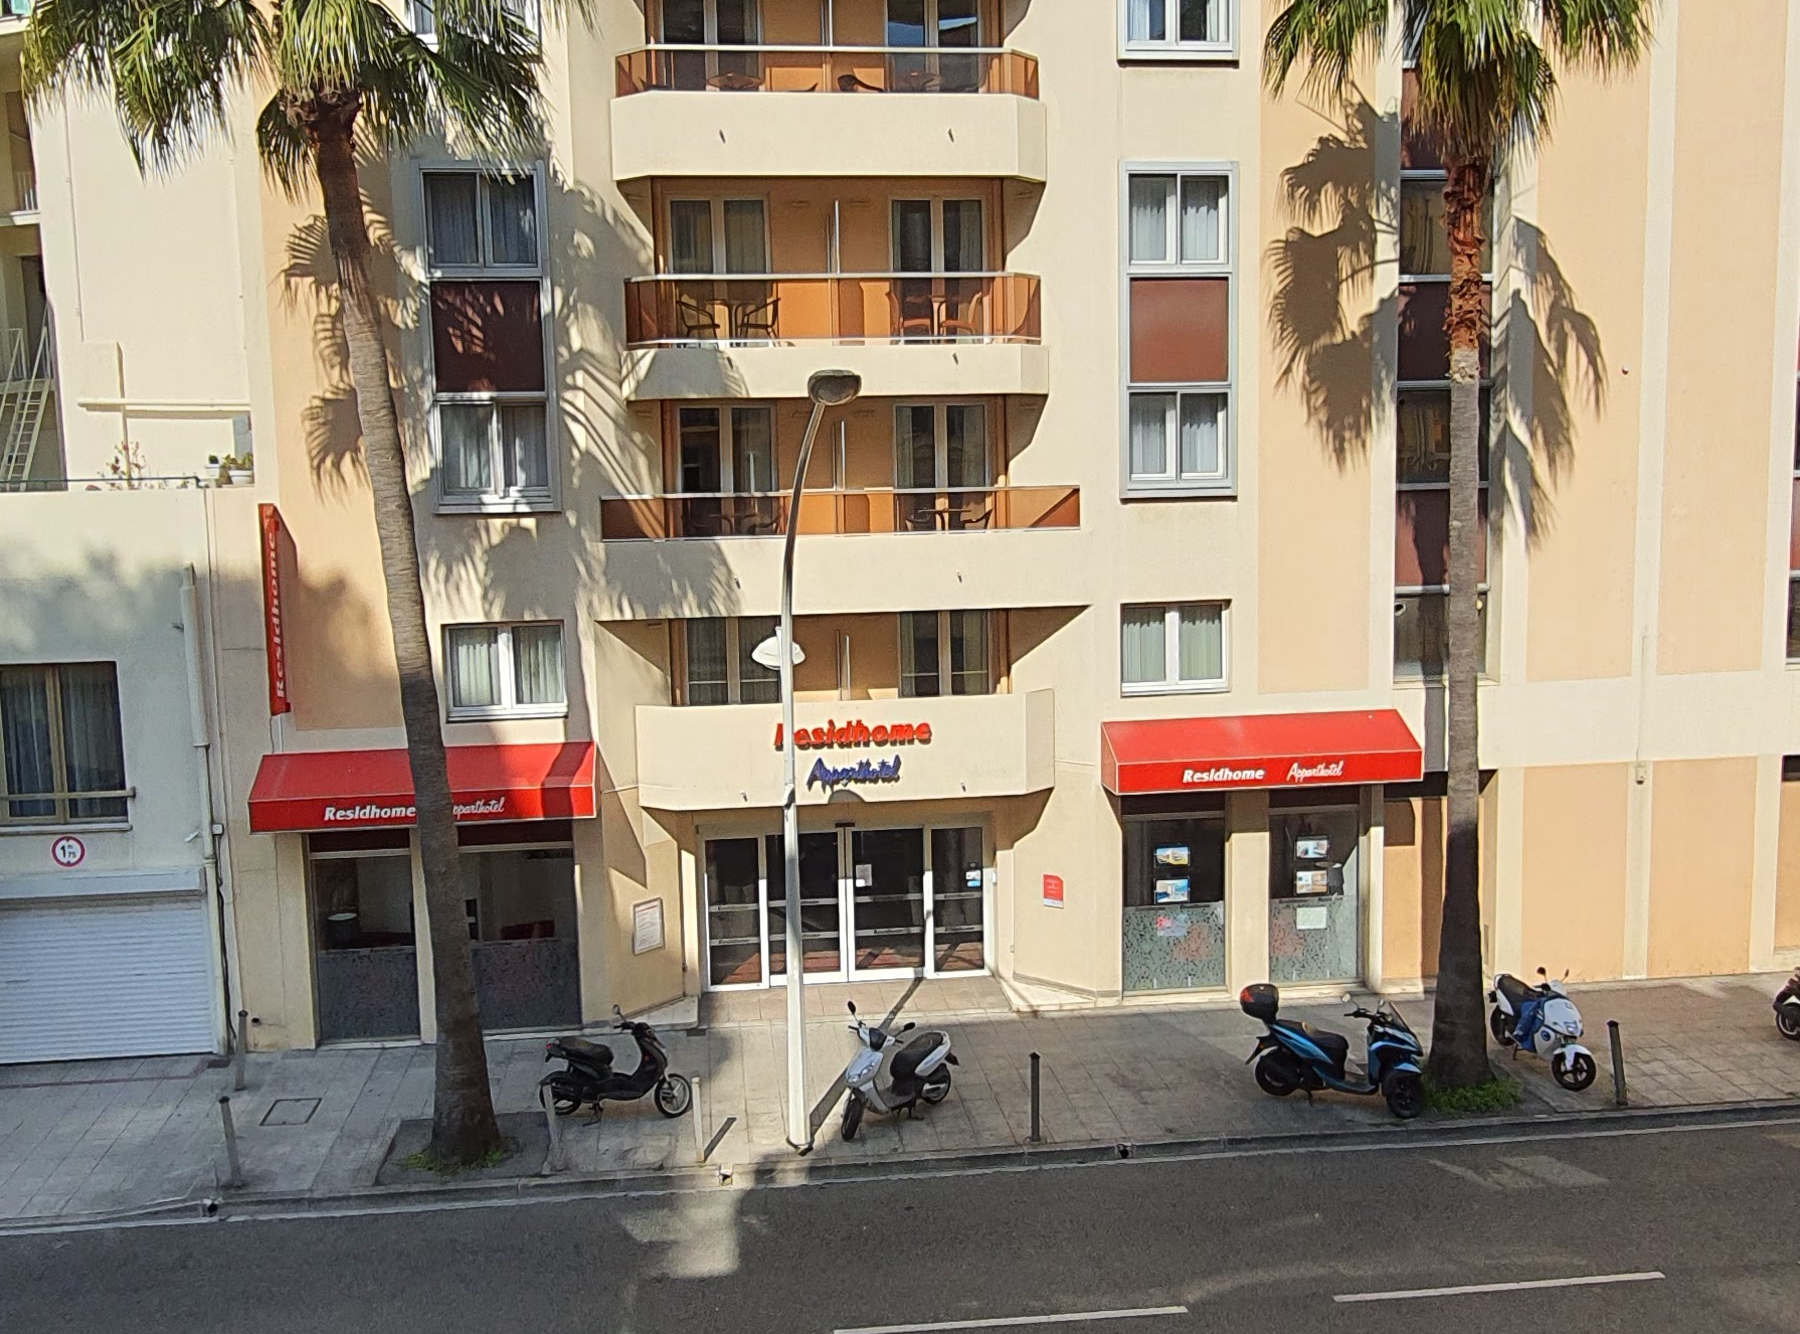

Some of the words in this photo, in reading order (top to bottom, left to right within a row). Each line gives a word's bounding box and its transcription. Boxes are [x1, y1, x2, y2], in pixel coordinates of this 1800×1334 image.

[1182, 767, 1266, 784] Residhome
[1285, 760, 1345, 783] Apparthotel
[323, 804, 417, 822] Residhome
